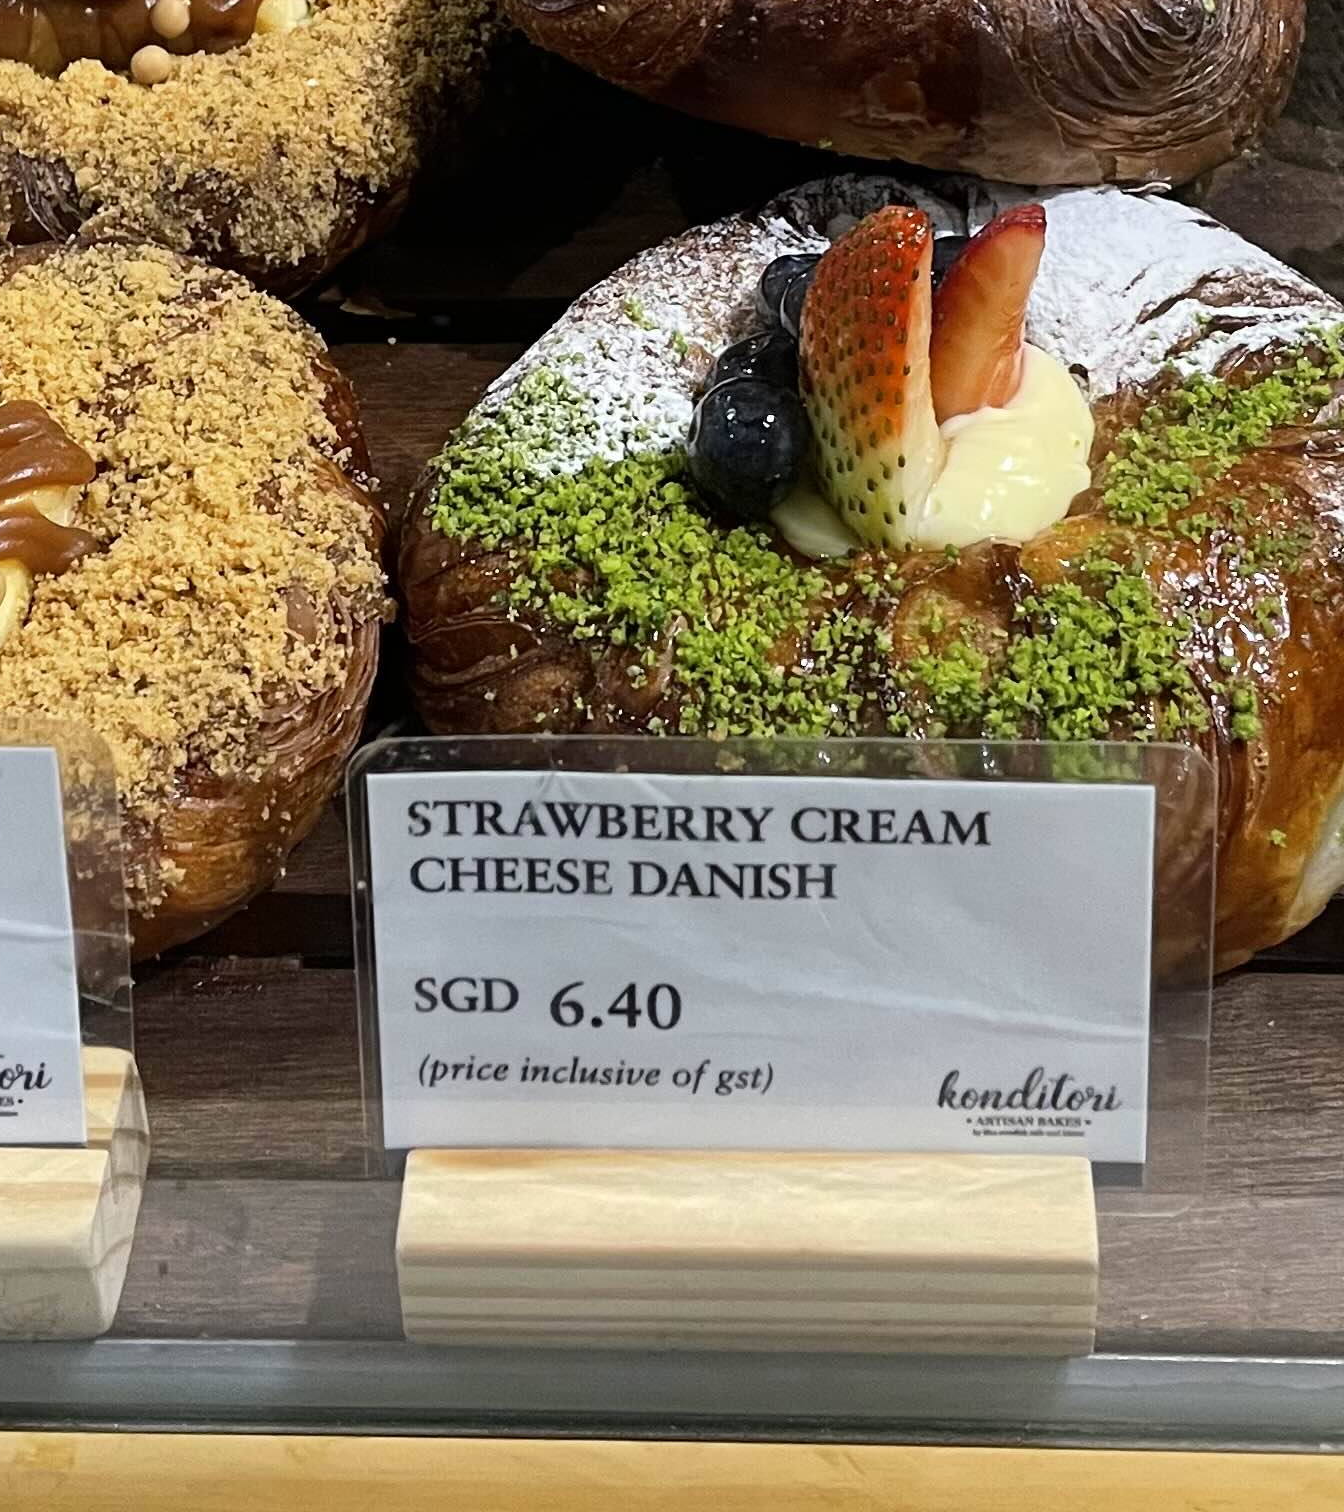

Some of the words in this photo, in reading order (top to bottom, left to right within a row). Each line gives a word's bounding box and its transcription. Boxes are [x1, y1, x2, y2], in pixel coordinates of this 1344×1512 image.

[408, 800, 772, 844] STRAWBERRY
[790, 806, 990, 846] CREAM
[409, 857, 613, 895] CHEESE
[631, 863, 837, 900] DANISH
[414, 977, 520, 1013] SGD
[549, 981, 683, 1031] 6.40
[419, 1054, 510, 1089] (price
[521, 1055, 662, 1090] inclusive
[672, 1061, 708, 1096] of
[716, 1062, 774, 1097] gst)
[938, 1067, 1122, 1111] konditori
